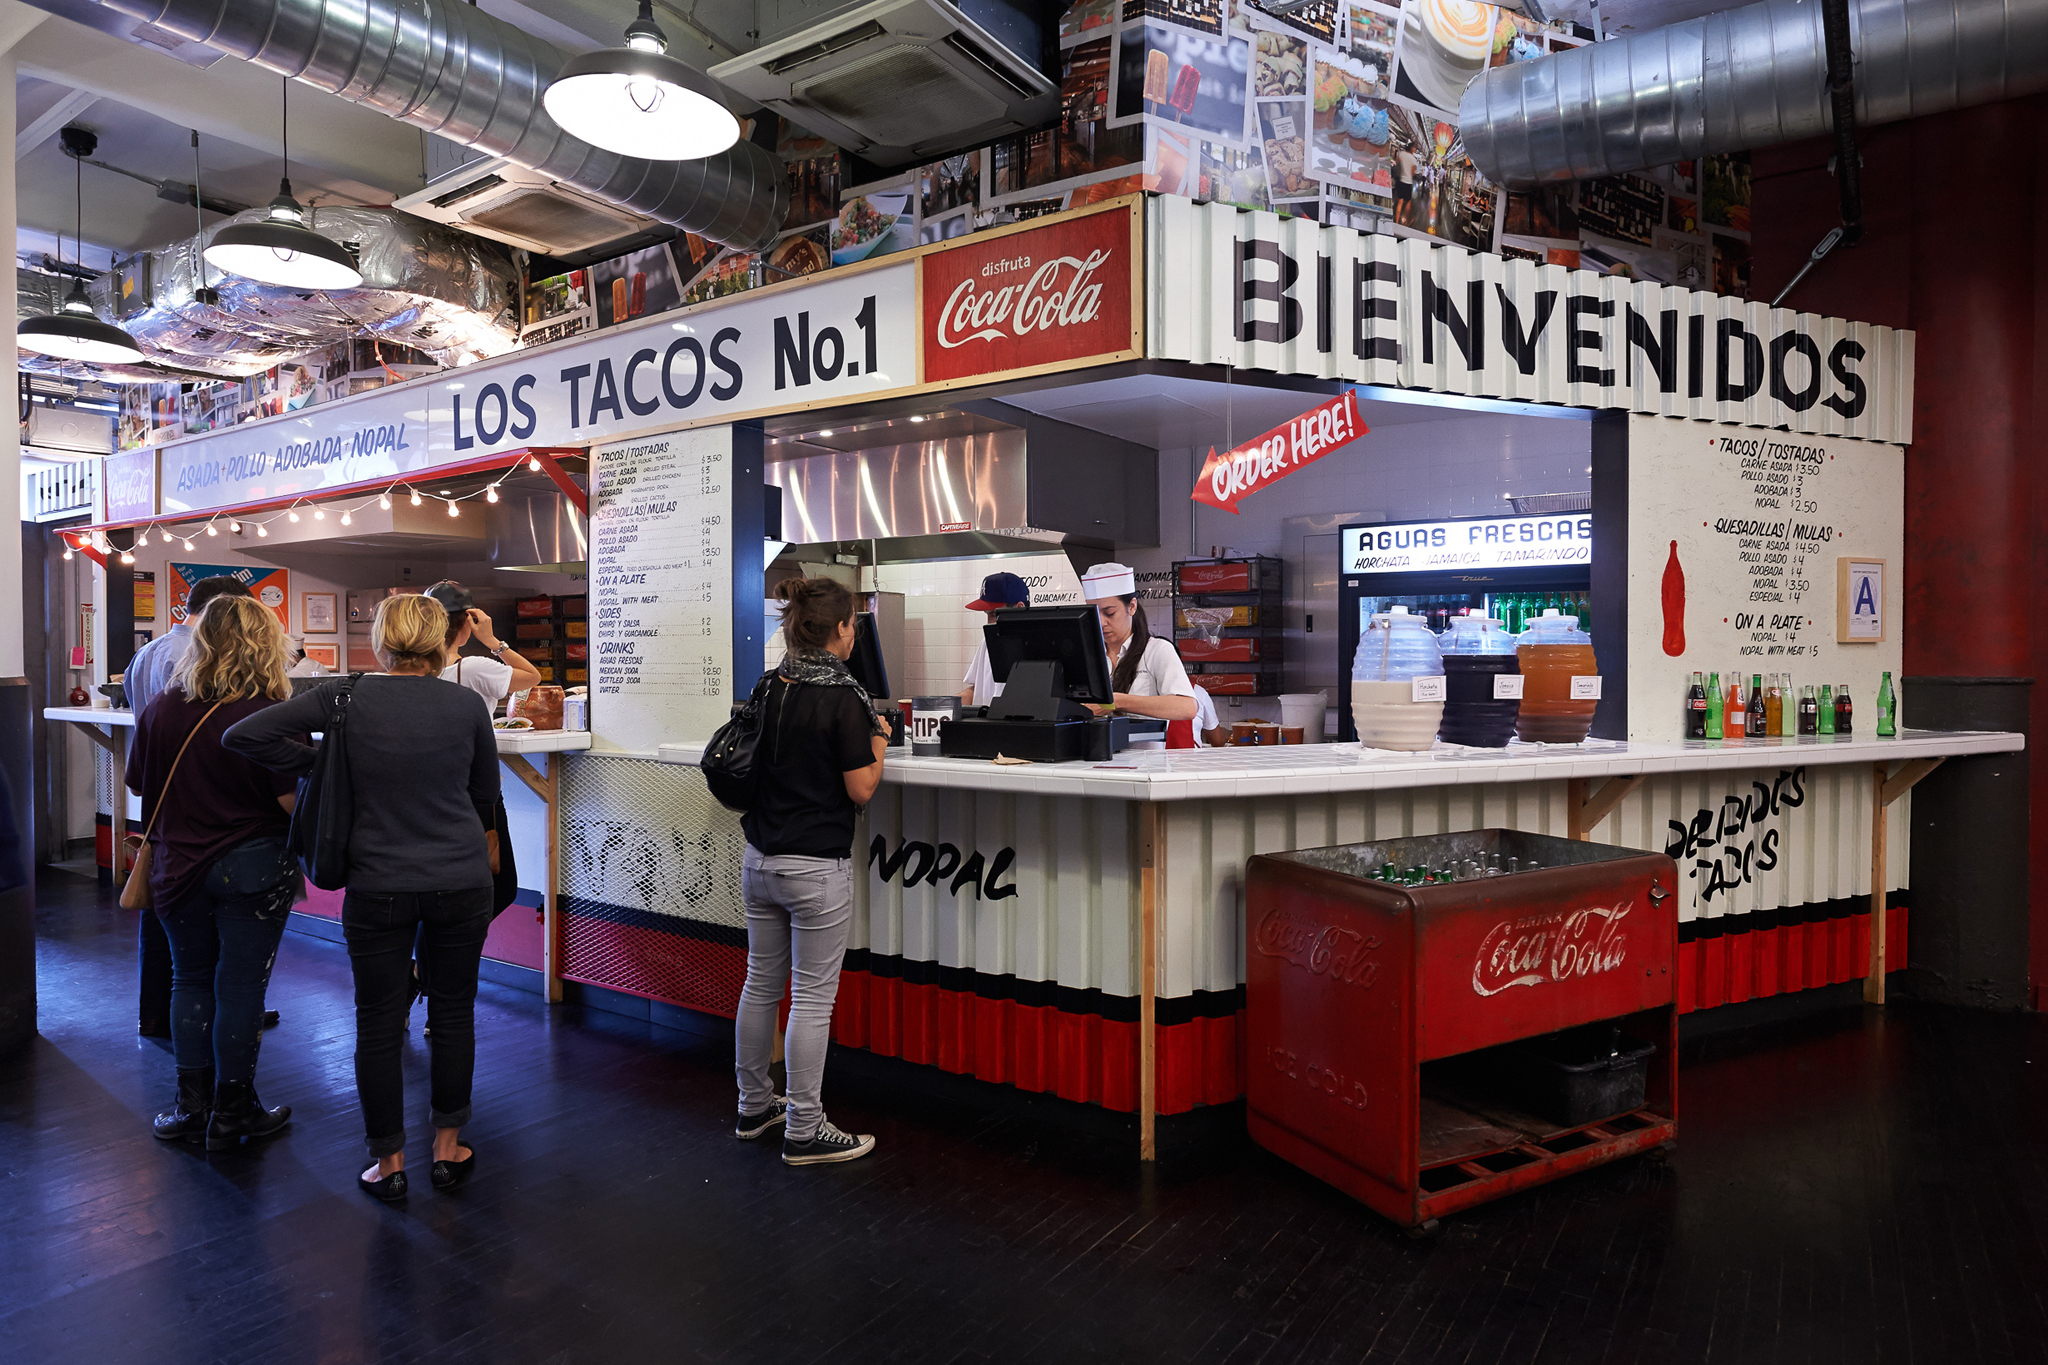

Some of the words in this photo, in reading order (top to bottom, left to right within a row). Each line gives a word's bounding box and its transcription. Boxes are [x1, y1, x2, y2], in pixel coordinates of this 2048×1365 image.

[981, 254, 1031, 277] disfruta
[937, 247, 1113, 349] Coca-Cola
[1233, 235, 1867, 420] BIENVENIDOS
[452, 373, 538, 452] LOS
[560, 326, 743, 429] TACOS
[773, 295, 878, 391] No.1
[1211, 434, 1288, 501] ORDER
[1291, 395, 1354, 465] HERE!
[1719, 437, 1826, 465] TACOS/TOSTADAS
[177, 461, 220, 492] ASADA
[226, 451, 267, 483] POLLO
[273, 436, 343, 474] ADOBADA
[351, 423, 410, 458] NOPAL
[655, 454, 676, 462] TORTILLA
[599, 470, 617, 480] CARNE
[619, 467, 638, 476] ASADA
[1741, 458, 1767, 470] CARNE
[1770, 461, 1793, 473] ASADA
[1795, 463, 1820, 476] $3.50
[598, 480, 614, 489] POLLO
[616, 477, 636, 486] ASADO
[661, 472, 681, 480] CHICKEN
[1741, 471, 1763, 482] POLLO
[1766, 473, 1789, 485] ASADO
[107, 467, 150, 509] Coca-Cola
[598, 488, 623, 498] ADOBADA
[1754, 484, 1789, 496] ADOBADA
[1755, 498, 1781, 509] NOPAL
[1791, 500, 1818, 513] $2.50
[598, 528, 618, 536] CARNE
[619, 525, 638, 535] ASADA
[1359, 528, 1446, 551] AGUAS
[1469, 519, 1592, 545] FRESCAS
[598, 537, 616, 546] POLLO
[618, 535, 638, 544] ASADO
[1739, 539, 1763, 550] CARNE
[1766, 541, 1789, 551] ASADA
[1795, 542, 1820, 554] $4.50
[598, 545, 625, 555] ADOBADA
[597, 557, 617, 565] NOPAL
[1354, 555, 1410, 569] HORCHATA
[1424, 551, 1480, 566] JAMAICA
[1496, 546, 1589, 562] TAMARINDO
[1739, 551, 1760, 562] POLLO
[1764, 553, 1787, 564] ASADO
[598, 566, 624, 574] ESPECIAL
[1748, 565, 1783, 576] ADOBADA
[599, 576, 611, 586] ON
[612, 576, 618, 585] A
[619, 574, 646, 585] PLATE
[1133, 572, 1173, 583] ANDMAD
[1753, 578, 1778, 589] NOPAL
[1785, 579, 1810, 591] $3.50
[598, 588, 618, 596] NOPAL
[1749, 591, 1784, 602] ESPECIAL
[1855, 577, 1876, 614] A
[598, 598, 619, 606] NOPAL
[622, 597, 639, 605] WITH
[641, 596, 659, 604] MEAT
[599, 607, 621, 619] SIDES
[599, 620, 616, 628] CHIPS
[617, 620, 622, 628] Y
[623, 619, 640, 628] SALSA
[1735, 612, 1754, 630] ON
[1756, 614, 1764, 629] A
[1770, 614, 1804, 630] PLATE
[599, 630, 615, 638] CHIPS
[618, 630, 623, 638] Y
[624, 629, 659, 638] GUACAMOLE
[1750, 632, 1777, 642] NOPAL
[600, 642, 635, 654] DRINKS
[1739, 646, 1764, 656] NOPAL
[1768, 645, 1785, 655] WITH
[1786, 646, 1806, 656] MEAT
[599, 686, 620, 694] WATER
[868, 834, 1018, 901] NOPAL
[1516, 912, 1564, 929] DRINK
[1256, 907, 1383, 990] Coca-Cola
[1472, 901, 1634, 997] Coca-Cola
[1267, 1042, 1297, 1079] ICE
[1306, 1062, 1368, 1110] COLD
